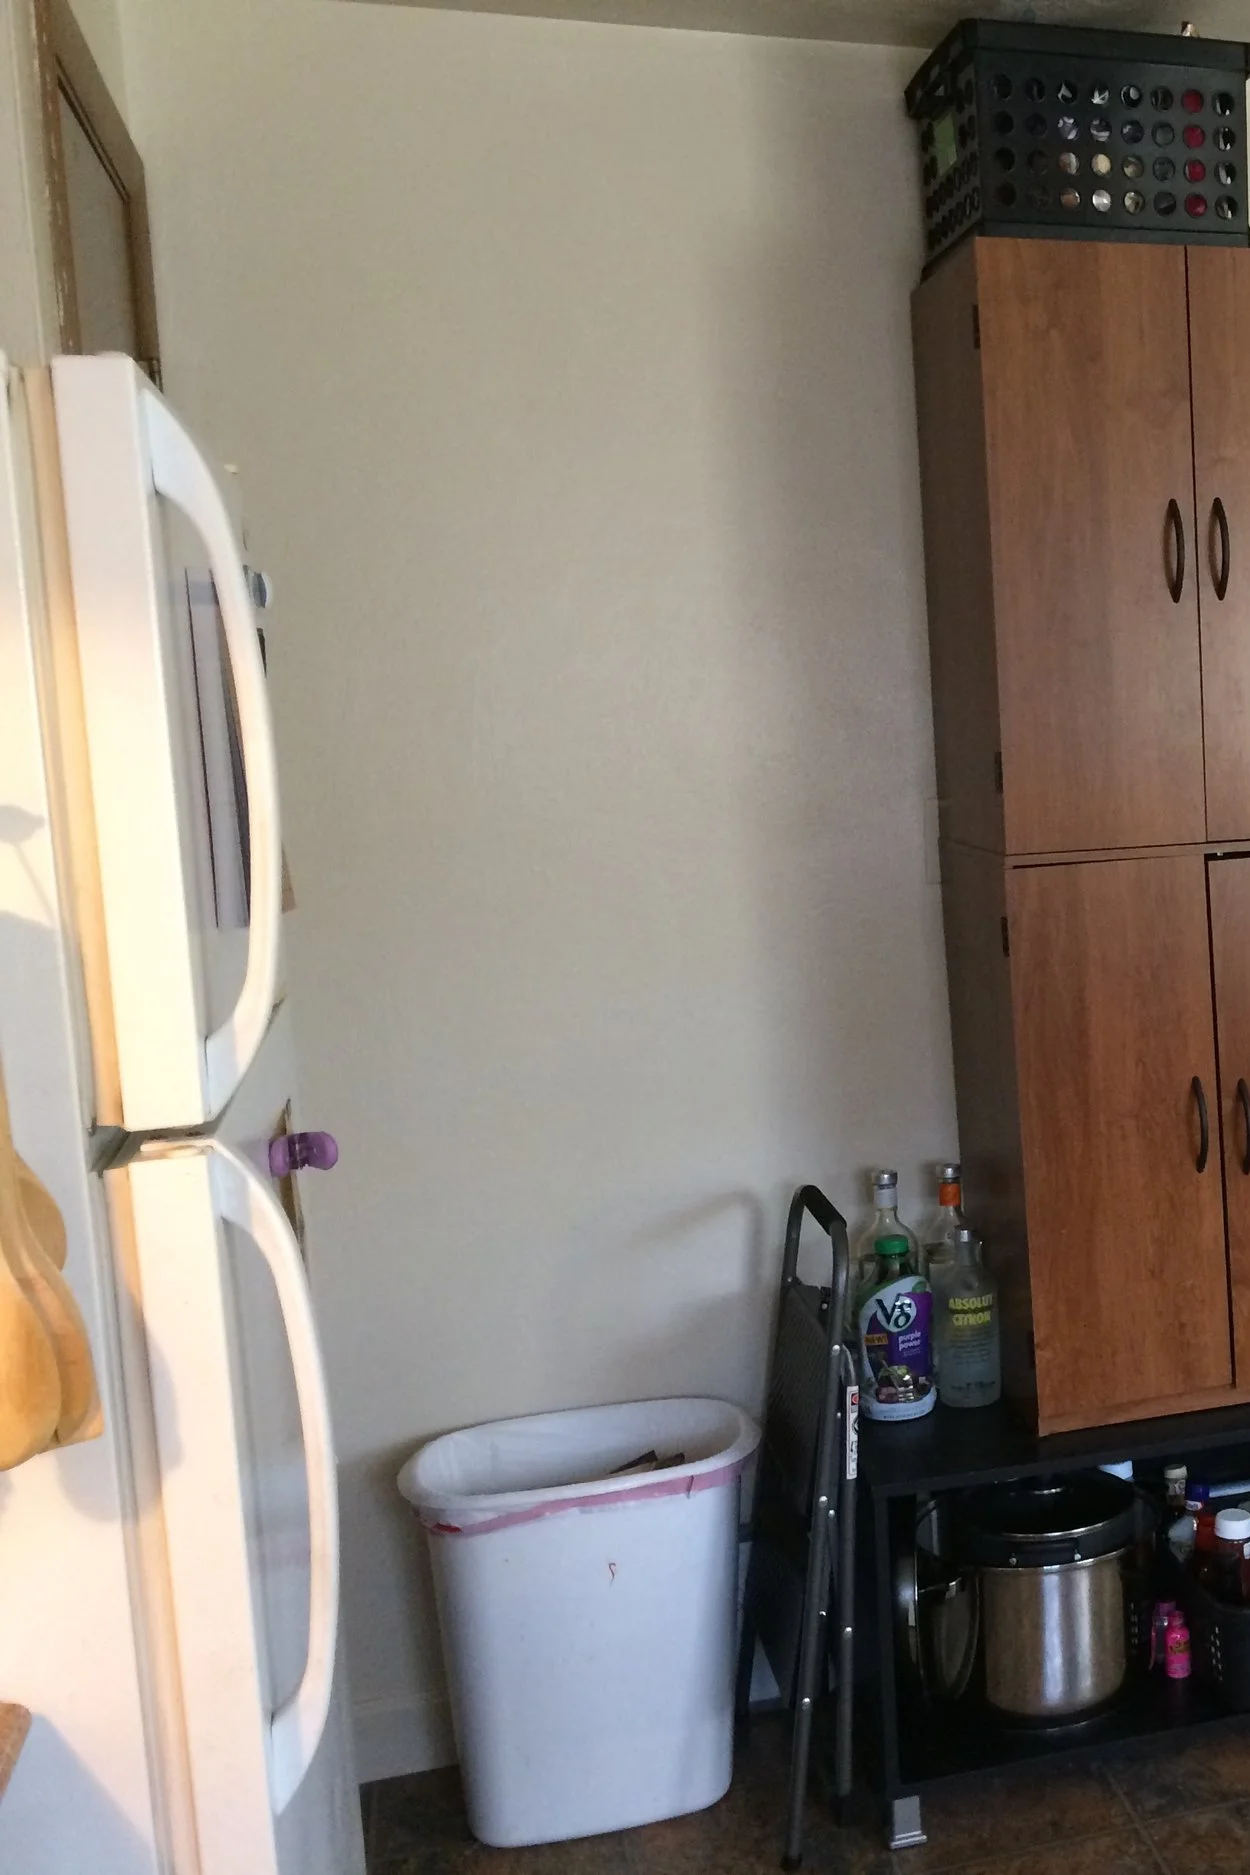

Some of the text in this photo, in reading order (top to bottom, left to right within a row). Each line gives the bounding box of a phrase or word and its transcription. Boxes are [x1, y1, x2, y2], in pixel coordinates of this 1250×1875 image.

[948, 1295, 993, 1310] ABSOLUT
[898, 1331, 922, 1342] purple
[898, 1339, 922, 1351] power
